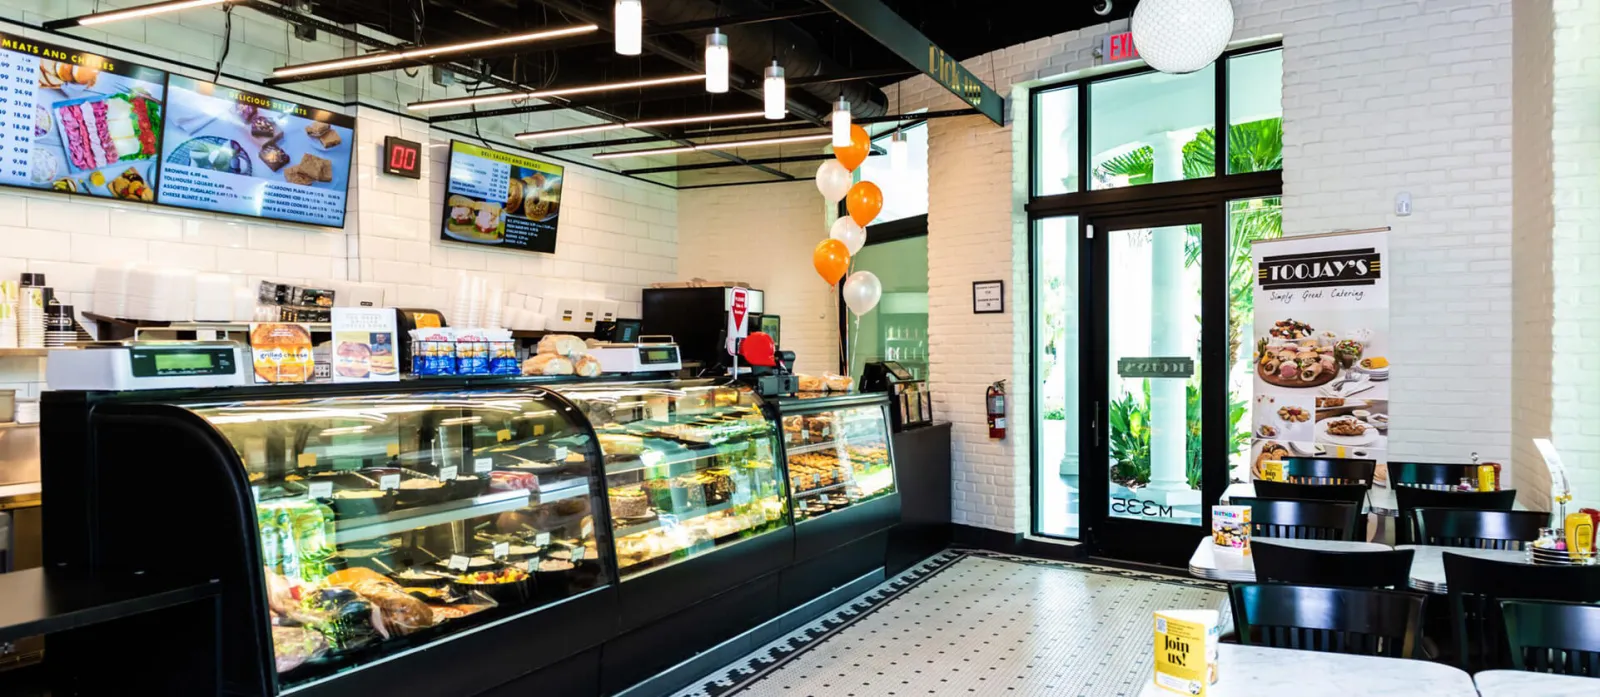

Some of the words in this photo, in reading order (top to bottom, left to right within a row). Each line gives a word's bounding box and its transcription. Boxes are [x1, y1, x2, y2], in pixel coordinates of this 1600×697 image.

[1110, 32, 1138, 60] EXI
[2, 39, 39, 54] MEATS
[43, 48, 67, 60] AND
[71, 55, 114, 71] CHES
[16, 65, 34, 74] 21.98
[929, 45, 960, 92] Pick
[16, 76, 34, 85] 21.98
[14, 88, 33, 97] 24.98
[13, 100, 32, 108] 31.98
[229, 91, 271, 107] DELICIOUS
[272, 102, 307, 116] DESRTS
[13, 146, 28, 154] 9.98
[12, 158, 27, 166] 9.98
[164, 167, 189, 176] BROWNIE
[163, 175, 192, 184] TOLLHOUSE
[163, 183, 189, 191] ASSORTED
[162, 191, 181, 199] CHEESE
[1269, 258, 1368, 281] TOOJAY'S
[260, 352, 282, 360] grilled
[1165, 635, 1190, 653] Join
[1167, 652, 1186, 667] us!
